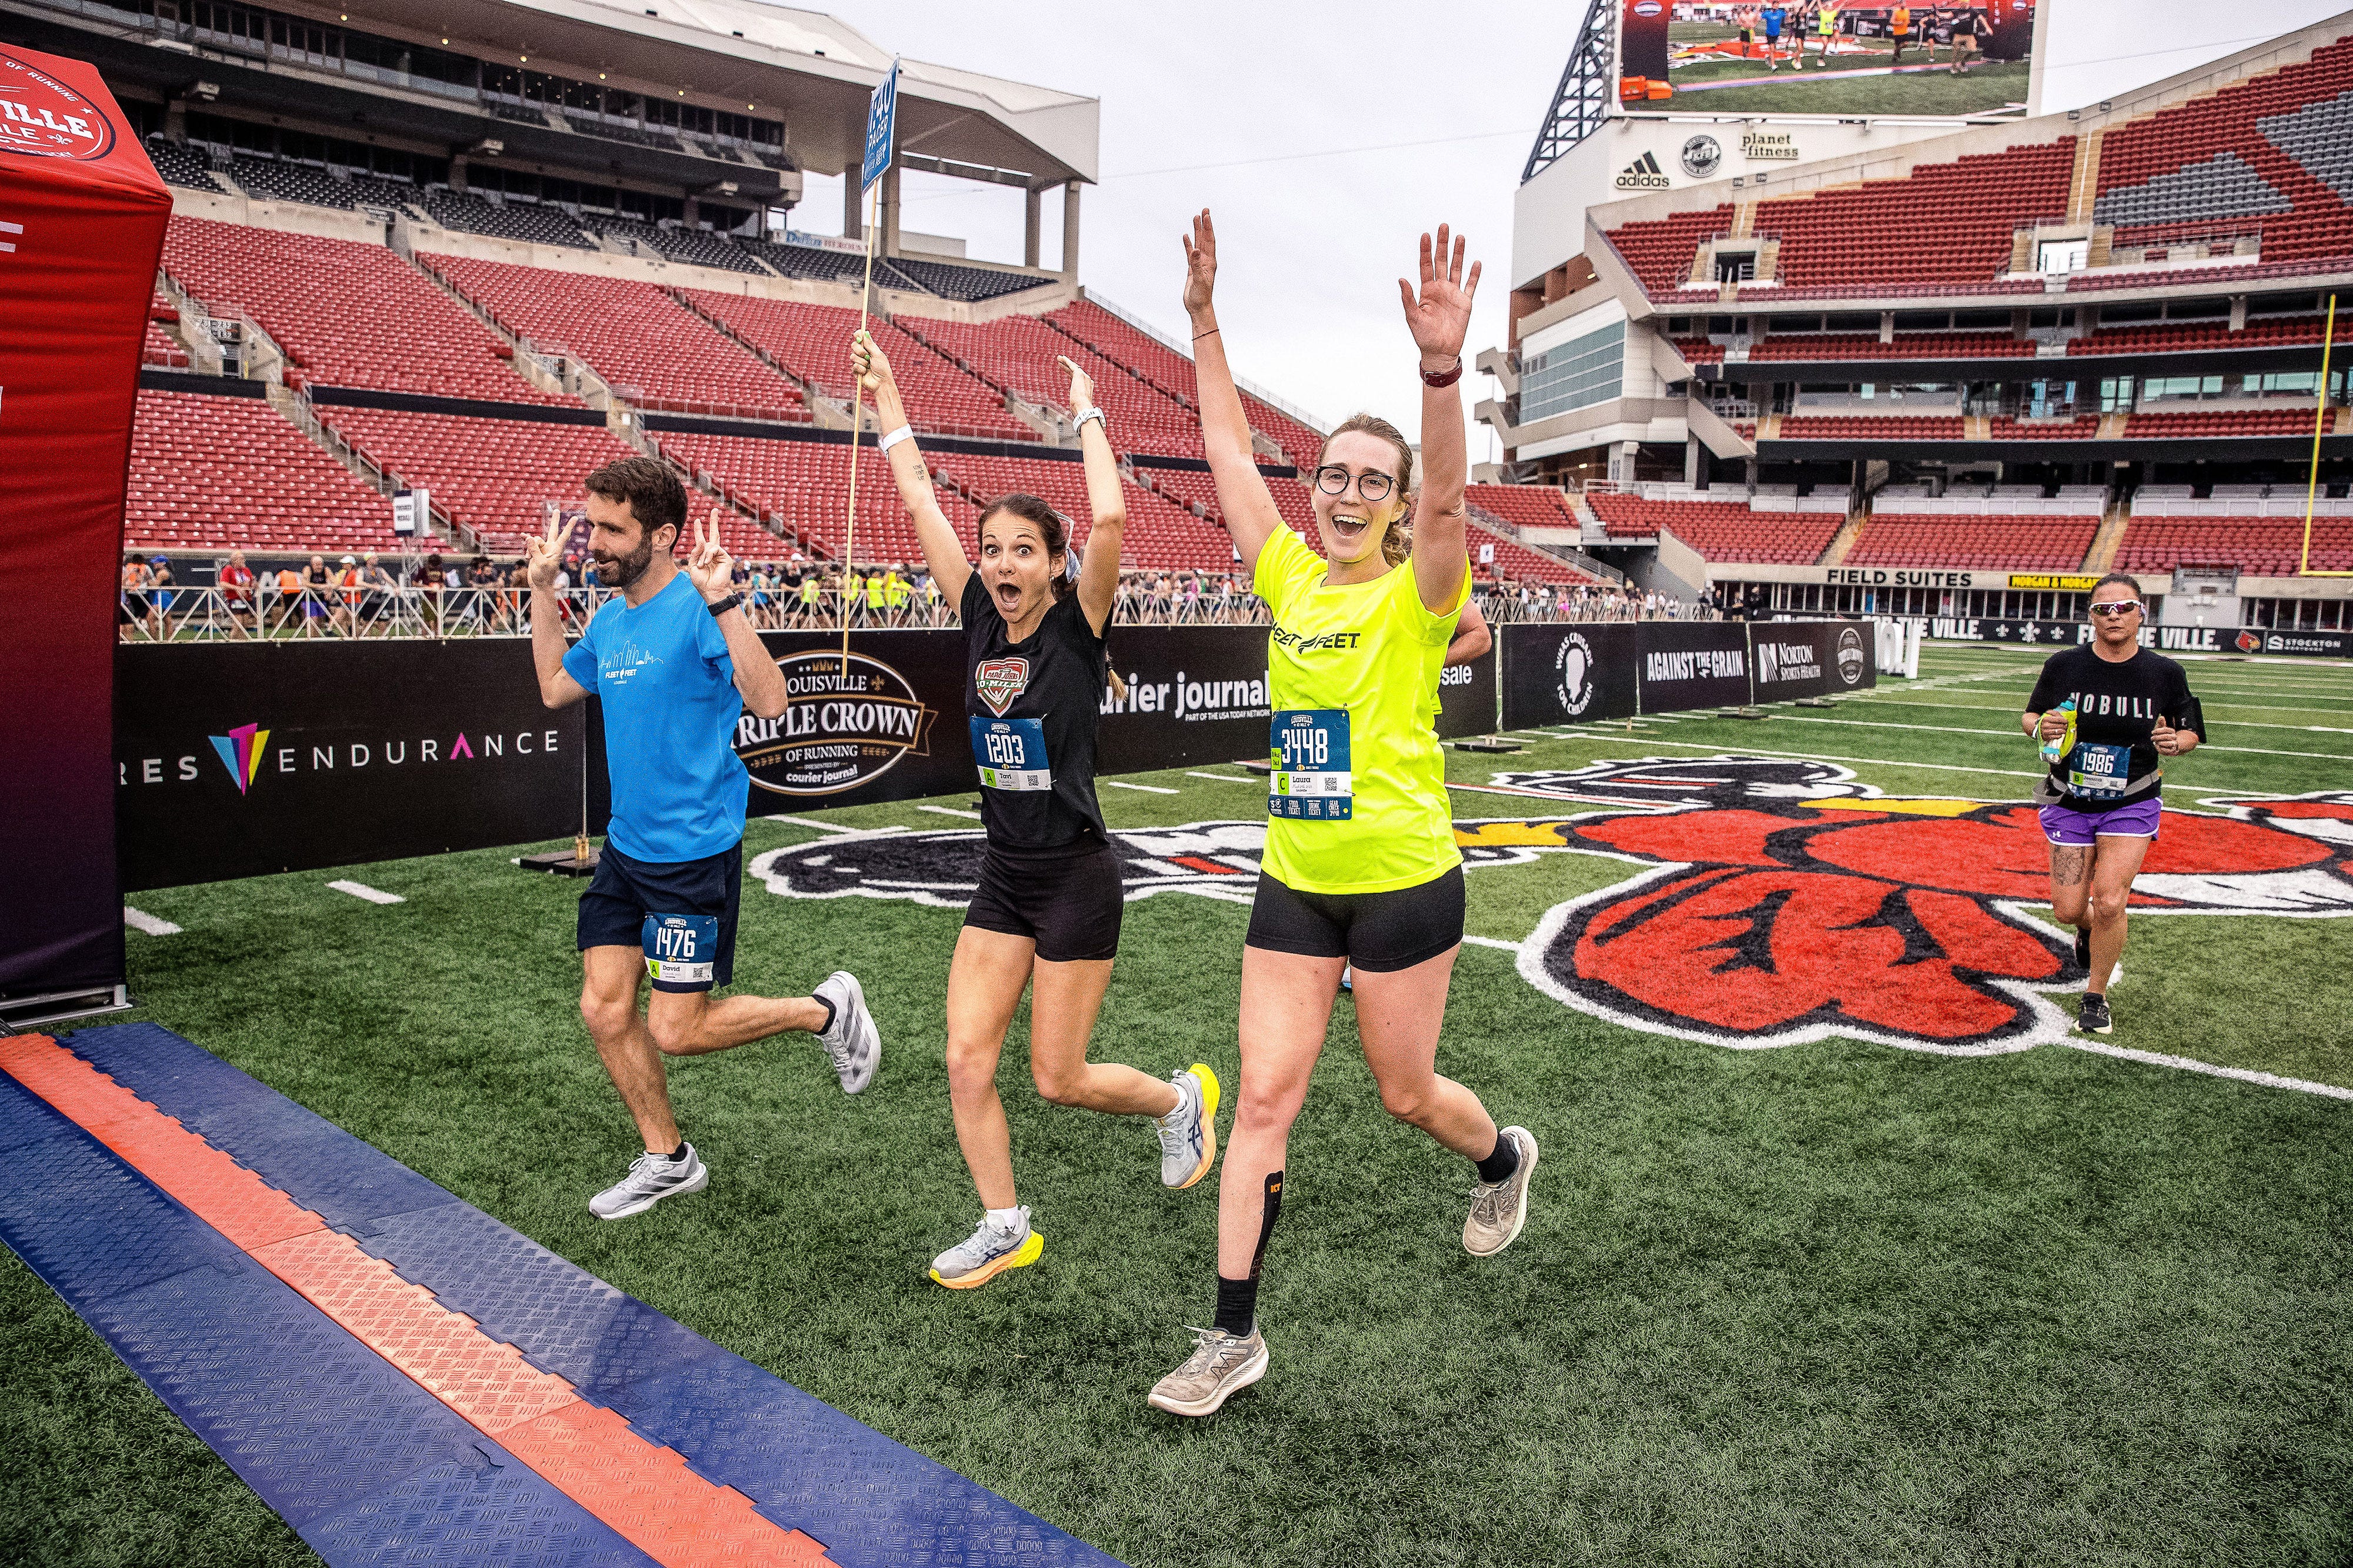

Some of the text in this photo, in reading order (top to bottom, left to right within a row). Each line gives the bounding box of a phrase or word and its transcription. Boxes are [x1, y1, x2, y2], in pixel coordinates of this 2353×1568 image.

[6, 61, 79, 102] OF RUNNING
[0, 123, 41, 140] LE
[868, 115, 888, 153] PACER
[1742, 133, 1791, 147] planet
[1747, 146, 1799, 157] fitness
[1616, 174, 1670, 188] adidas
[1827, 569, 1972, 587] FIELD SUITES
[2012, 576, 2051, 587] MORGAN
[2051, 577, 2059, 588] &
[1932, 618, 1984, 640] VILLE.
[2161, 628, 2221, 652] VILLE.
[2284, 638, 2341, 648] STOCKTON
[1555, 632, 1594, 669] WHAS CRUSADE
[605, 669, 637, 679] FLEET FEET
[1441, 665, 1472, 686] sale
[1647, 650, 1744, 682] AGAINST THE GRAIN
[1780, 665, 1801, 682] SPORTS
[786, 675, 867, 694] OUISVILLE
[1099, 670, 1271, 719] urier journal
[1557, 681, 1593, 715] FOR CHILDREN
[730, 702, 919, 749] RIPLE CROWN
[1185, 712, 1199, 722] PART
[1199, 712, 1208, 721] OF
[1208, 712, 1218, 720] THE
[1229, 710, 1247, 719] TODAY
[278, 729, 558, 773] ENDURANCE
[785, 745, 858, 763] OF RUNNING
[985, 733, 1025, 764] 1203
[1281, 728, 1328, 764] 3448
[2082, 752, 2115, 774] 1986
[785, 771, 823, 783] courier
[823, 764, 858, 784] journal
[987, 772, 994, 783] A
[1279, 778, 1286, 790] C
[1288, 807, 1301, 815] TICKET
[656, 927, 696, 958] 1476
[652, 965, 657, 975] A
